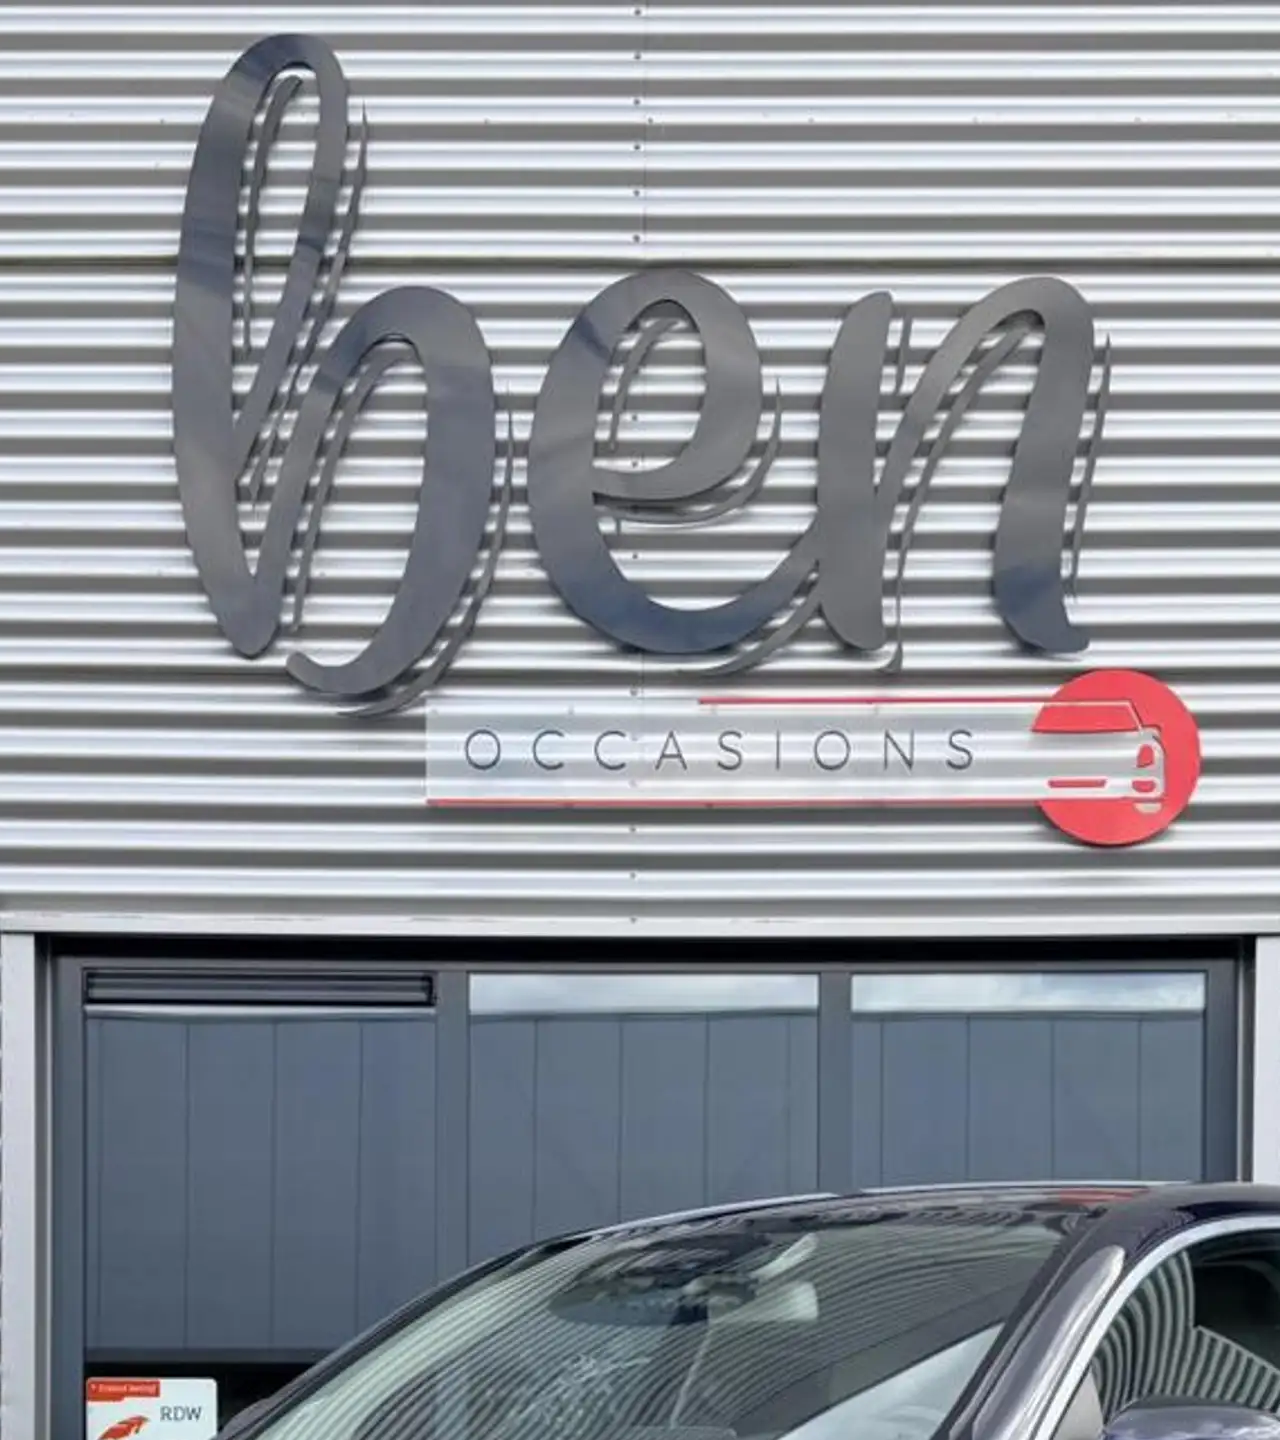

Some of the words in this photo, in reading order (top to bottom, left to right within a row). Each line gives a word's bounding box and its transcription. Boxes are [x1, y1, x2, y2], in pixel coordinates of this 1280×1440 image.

[172, 33, 1091, 698] ben
[463, 727, 976, 772] OCCASIONS
[159, 1405, 202, 1422] RDW
